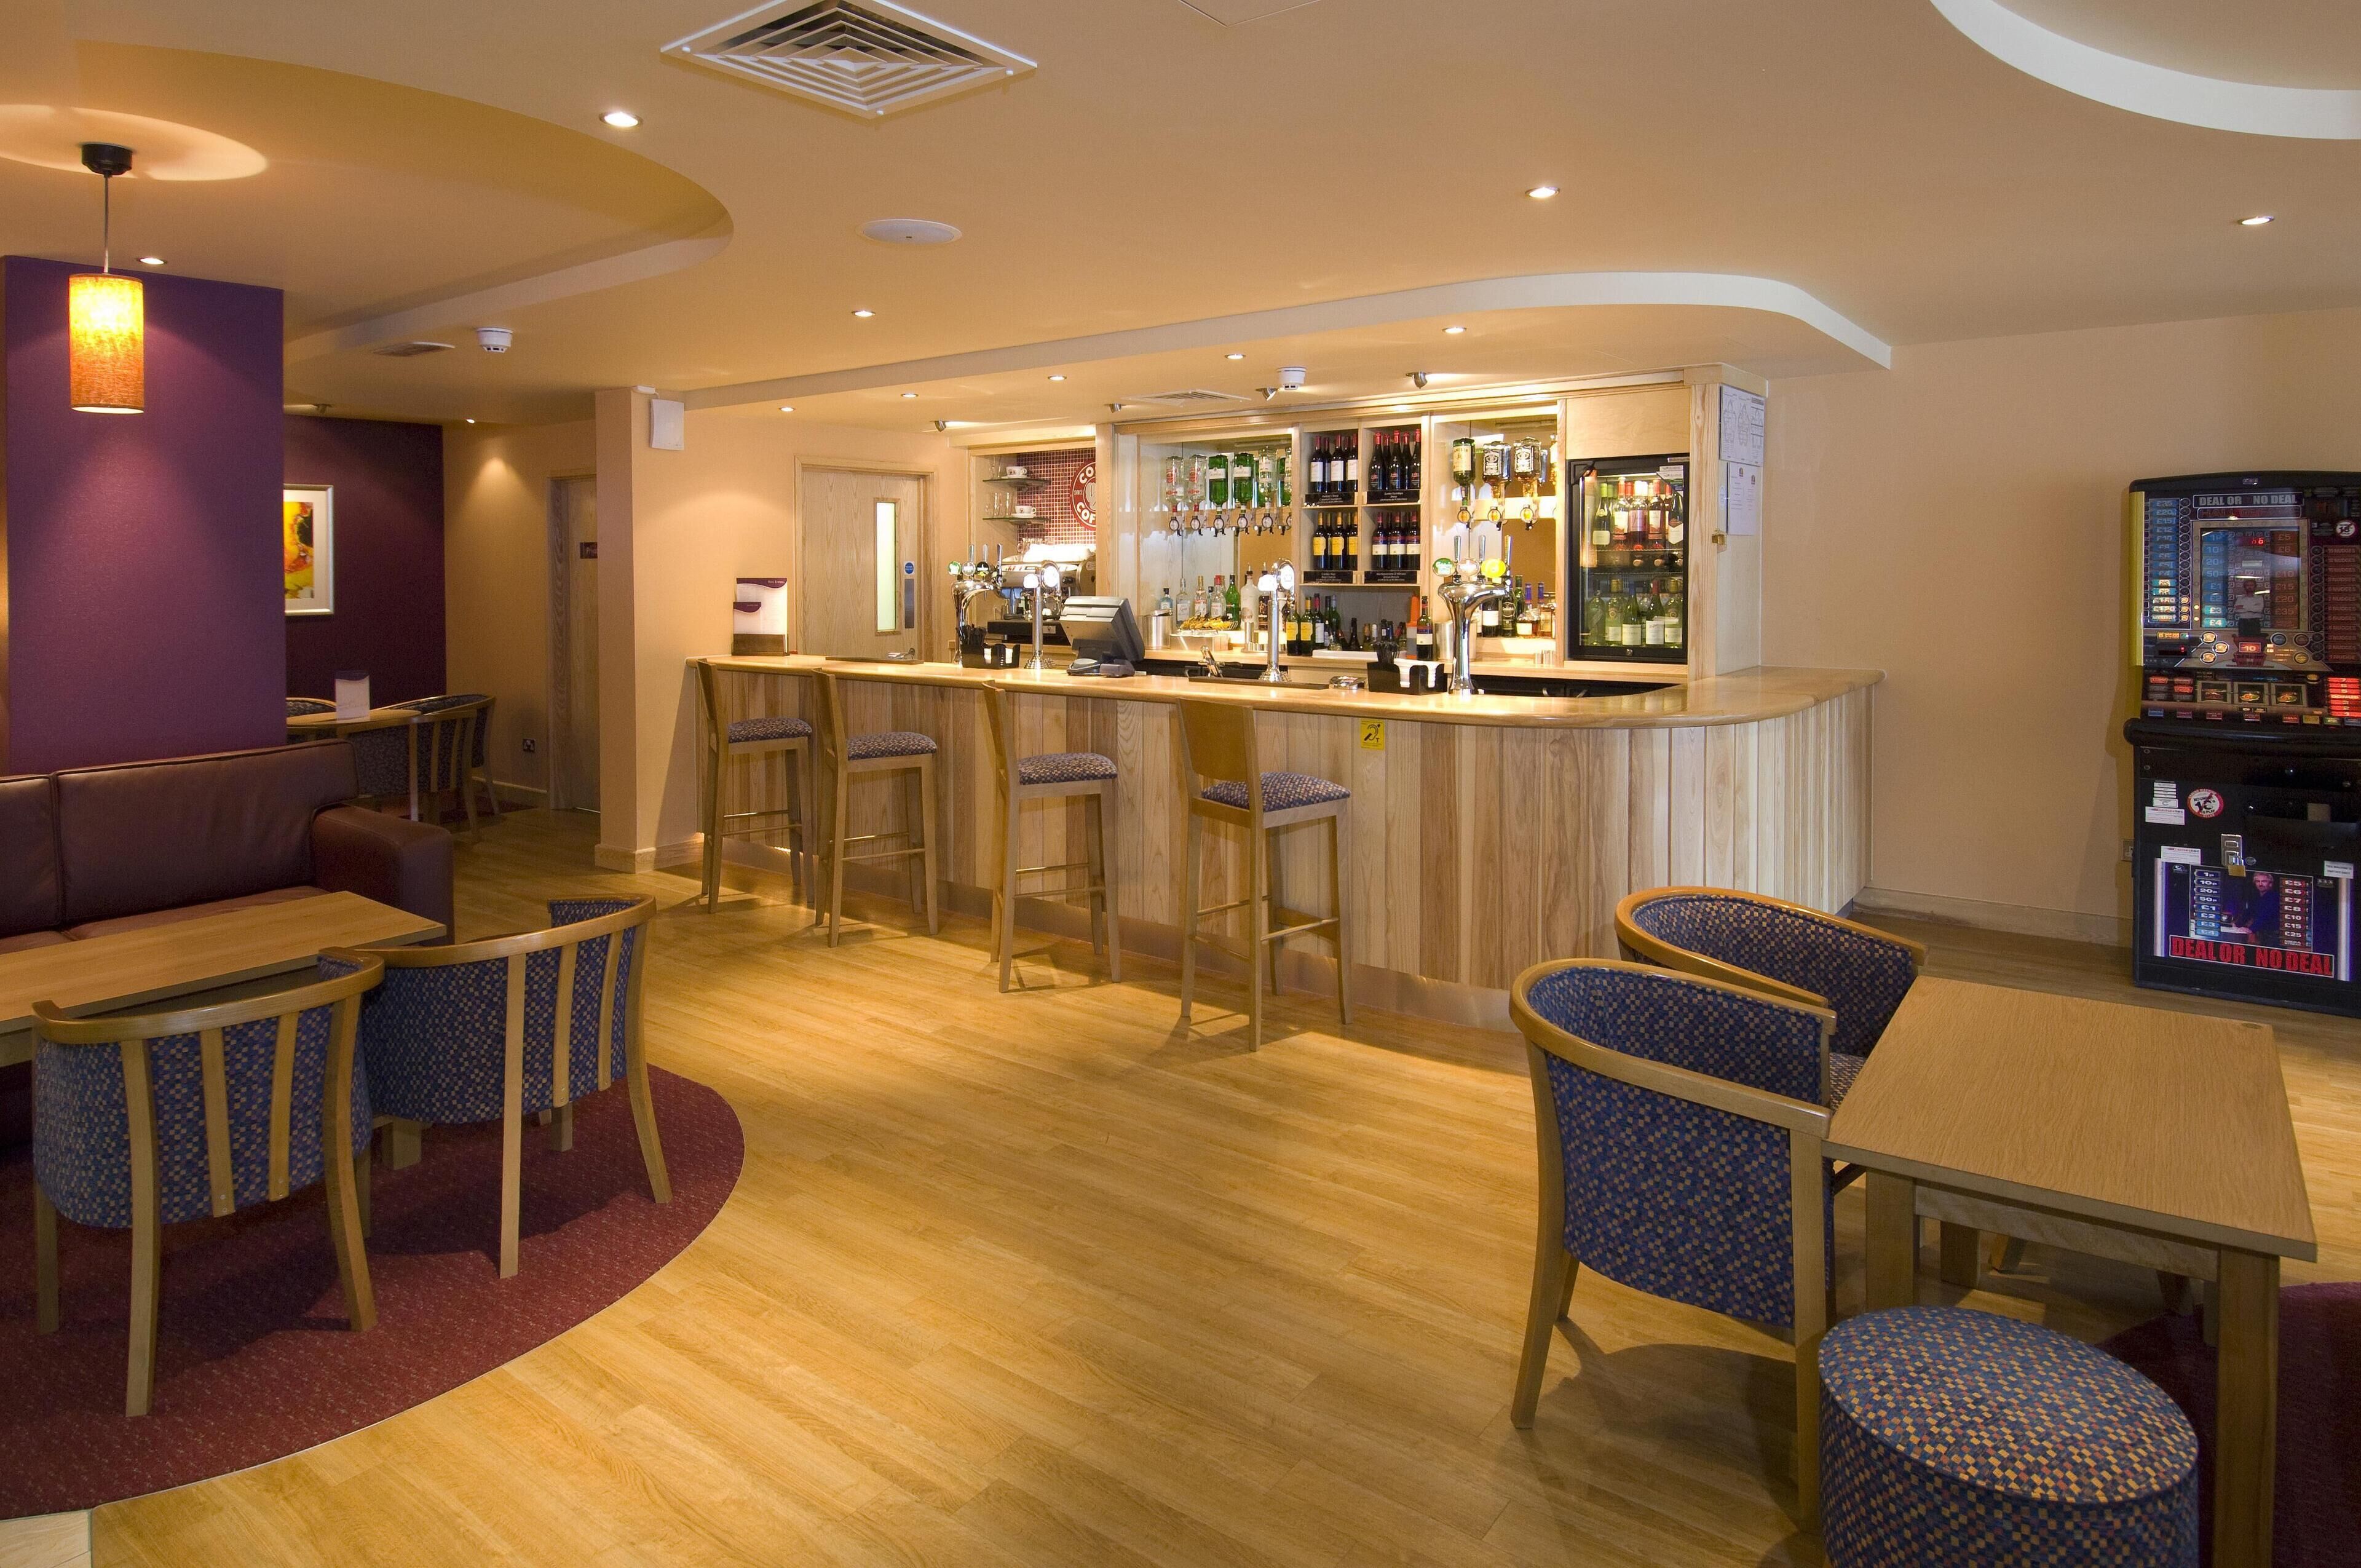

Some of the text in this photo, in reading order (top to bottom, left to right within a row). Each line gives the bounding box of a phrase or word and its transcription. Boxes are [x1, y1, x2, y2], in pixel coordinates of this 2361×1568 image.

[2199, 496, 2225, 505] DEAL
[2253, 495, 2268, 504] NO
[2271, 494, 2298, 504] DEAL
[2172, 937, 2333, 976] DEAL OR NO DEAL
